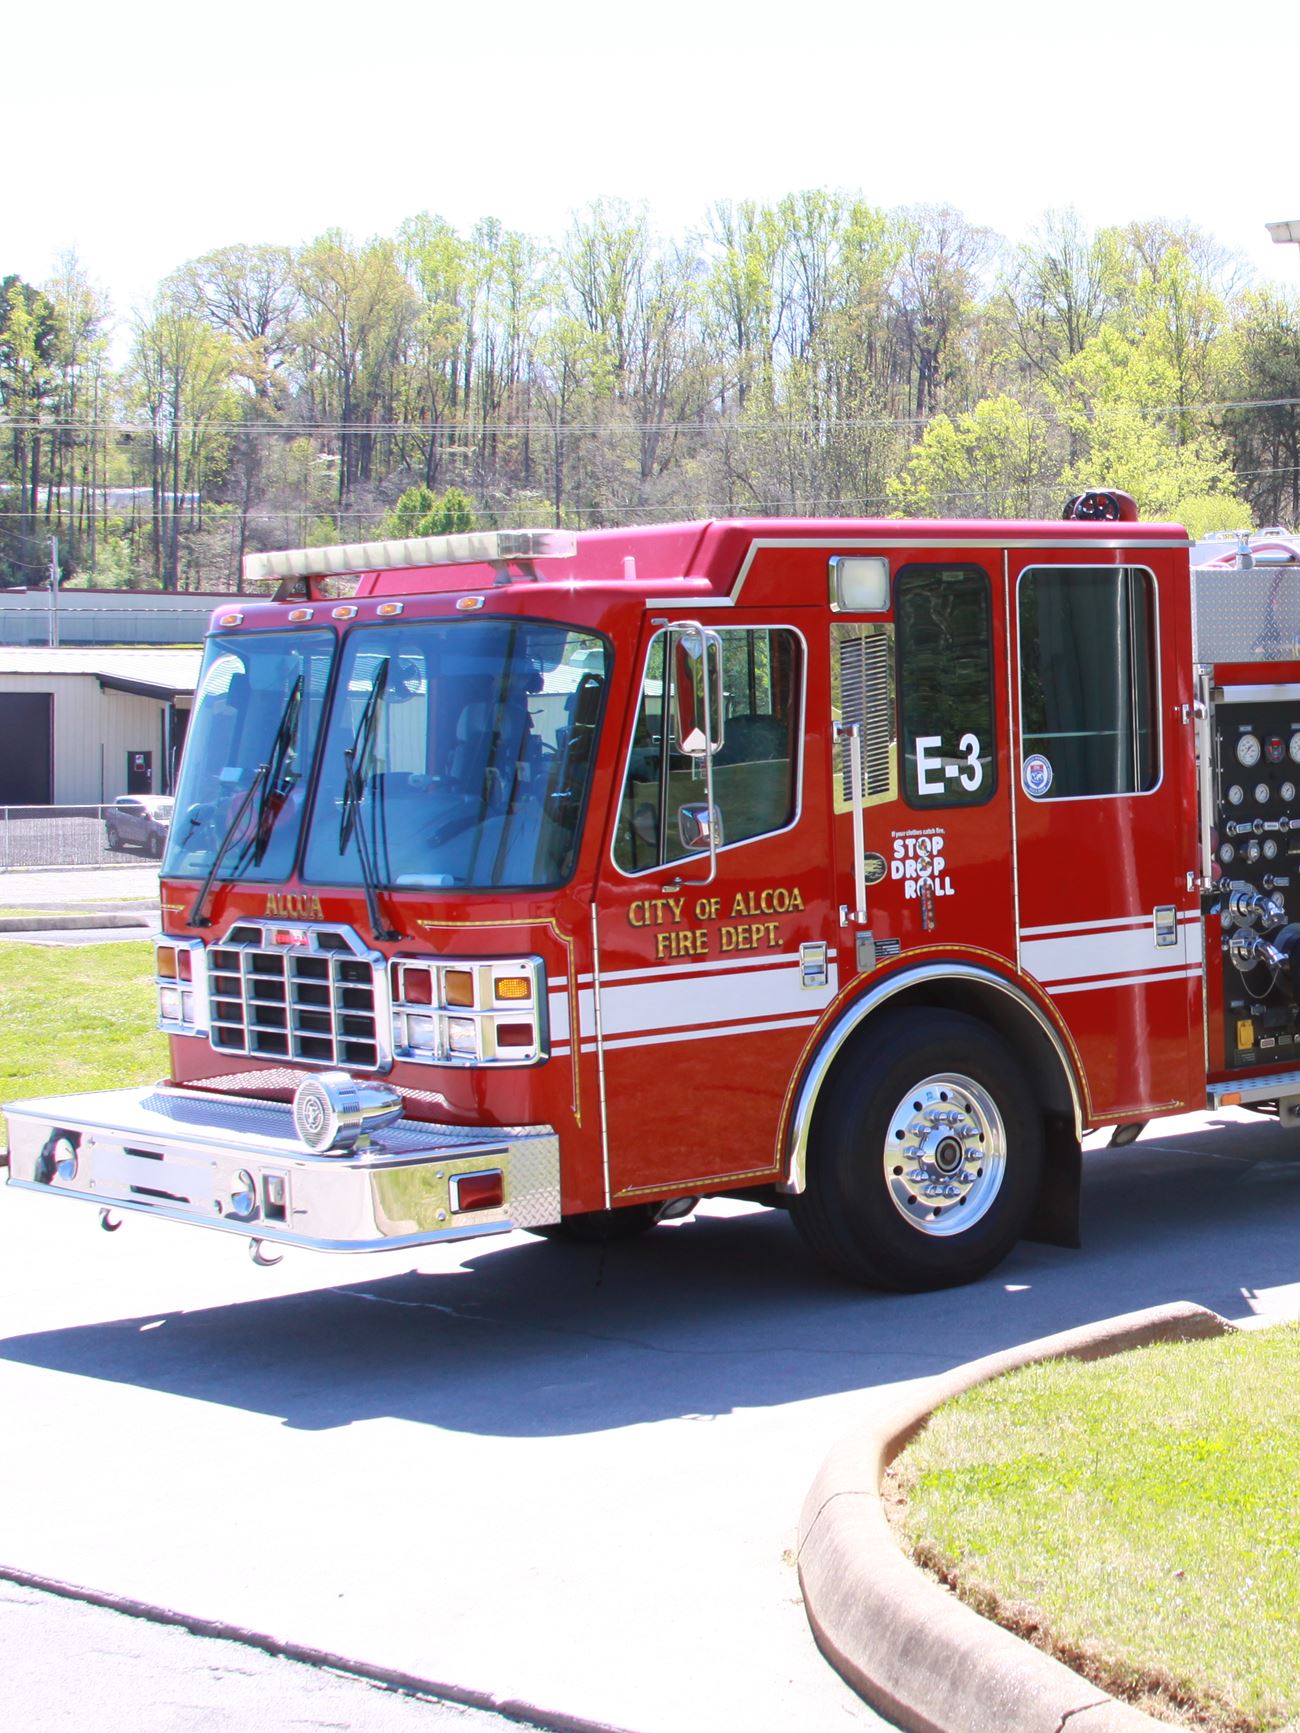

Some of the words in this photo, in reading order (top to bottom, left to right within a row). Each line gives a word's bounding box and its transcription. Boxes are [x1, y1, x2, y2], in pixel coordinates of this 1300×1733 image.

[916, 733, 983, 796] E-3
[893, 836, 944, 858] STOP
[890, 856, 945, 880] DROP
[904, 876, 955, 900] ROLL
[265, 890, 324, 919] ALCOA
[628, 897, 686, 927] CITY
[695, 897, 721, 921] OF
[730, 887, 805, 917] ALCOA
[656, 929, 709, 959] FIRE
[720, 922, 784, 951] DEPT.
